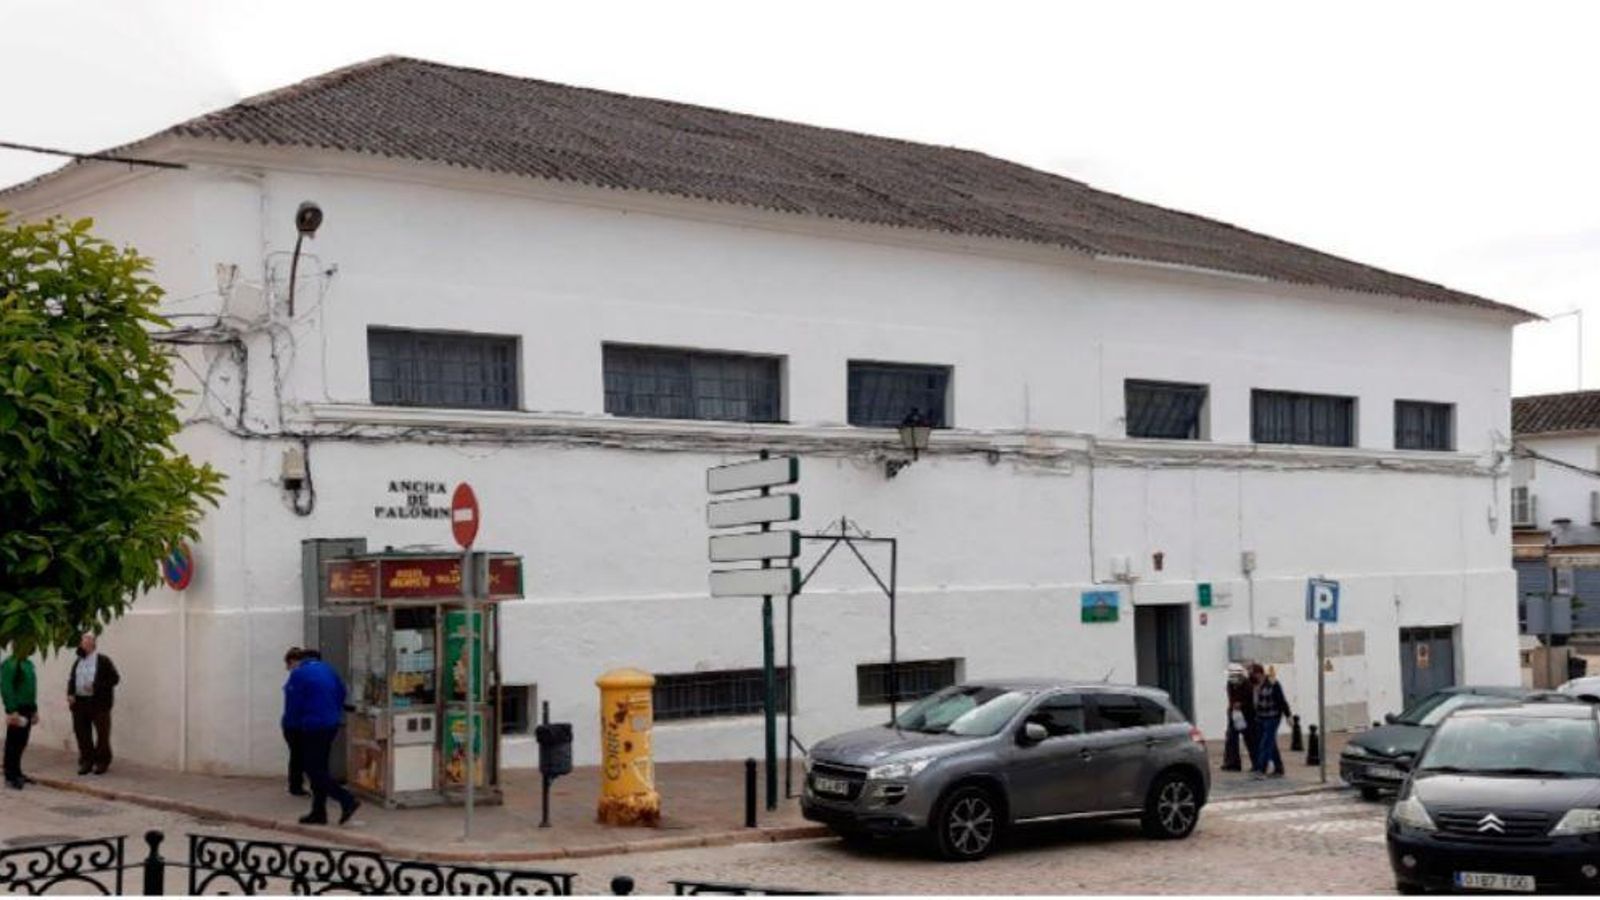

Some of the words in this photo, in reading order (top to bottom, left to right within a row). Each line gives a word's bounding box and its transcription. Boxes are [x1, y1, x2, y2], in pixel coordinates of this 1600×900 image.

[387, 480, 447, 494] ANCHA
[406, 494, 429, 507] DE
[374, 506, 451, 519] PALOMIN
[1313, 585, 1334, 619] P
